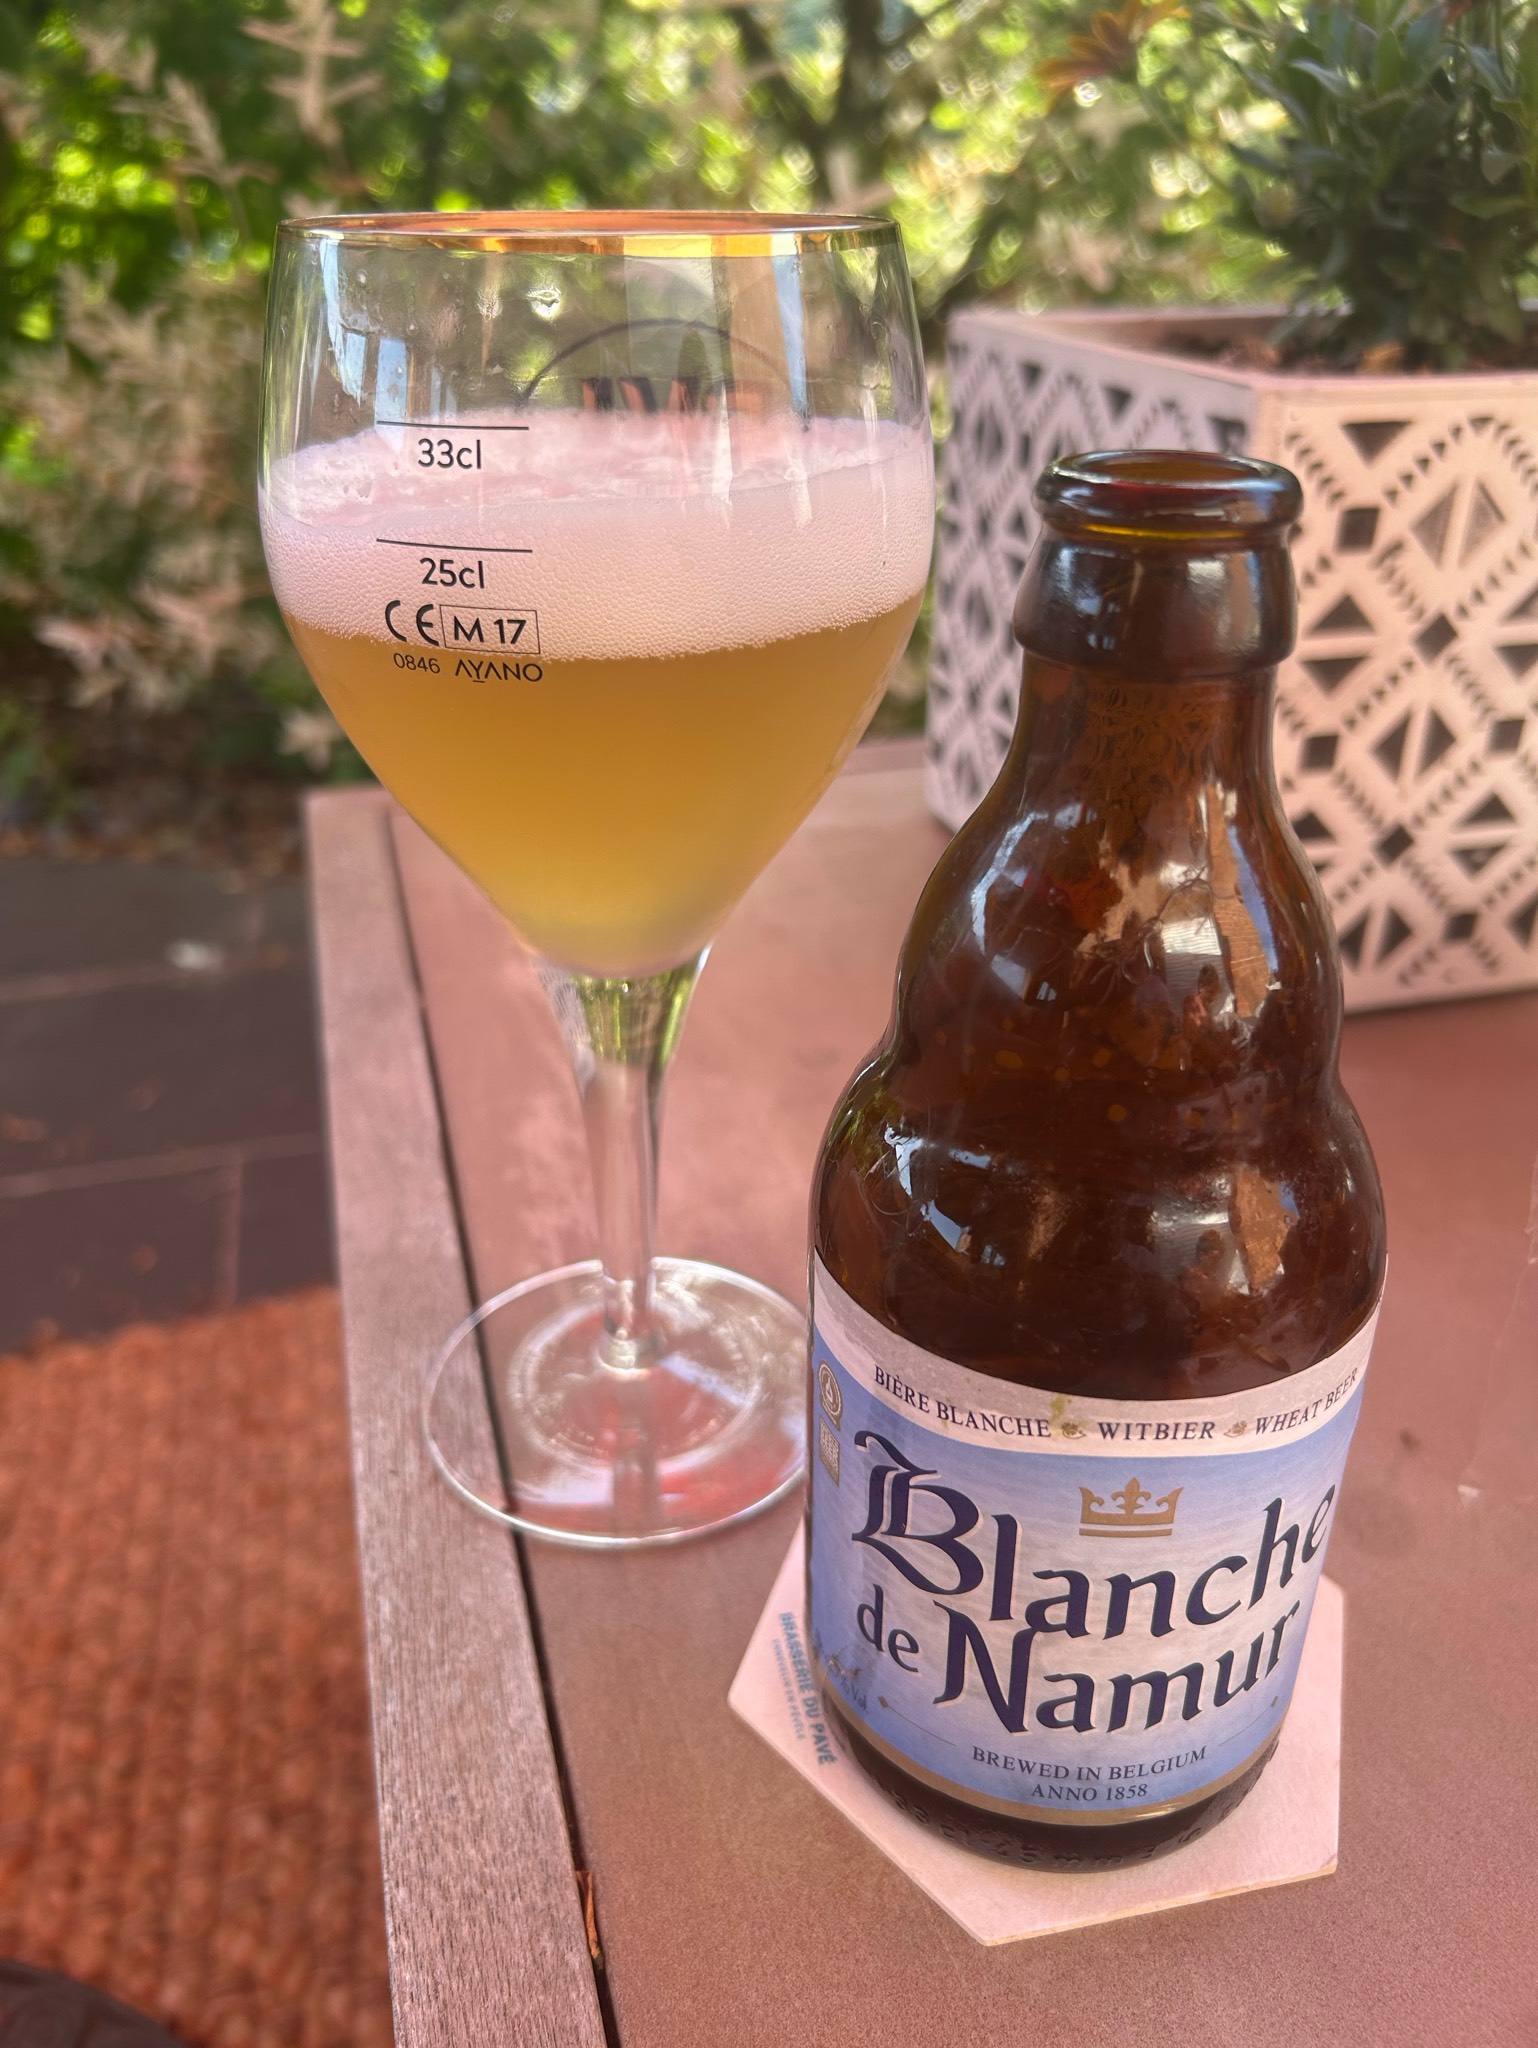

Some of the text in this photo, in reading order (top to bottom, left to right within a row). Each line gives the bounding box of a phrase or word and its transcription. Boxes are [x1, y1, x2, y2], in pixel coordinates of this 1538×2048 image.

[418, 438, 482, 469] 33cl
[420, 558, 485, 589] 25cl
[494, 618, 527, 645] 17
[393, 653, 440, 674] 0846
[875, 1364, 930, 1413] BIÈRE
[936, 1400, 1052, 1437] BLANCHE
[1097, 1421, 1216, 1441] WITBIER
[1255, 1399, 1322, 1435] WHEAT
[1324, 1367, 1357, 1411] BEER
[851, 1430, 1336, 1640] Blanche
[779, 1612, 815, 1693] BRASSERIE
[802, 1696, 820, 1718] DU
[857, 1584, 1300, 1734] de Namur
[972, 1745, 1207, 1782] BREWED IN BELGIUM
[1031, 1783, 1148, 1801] ANNO 1858
